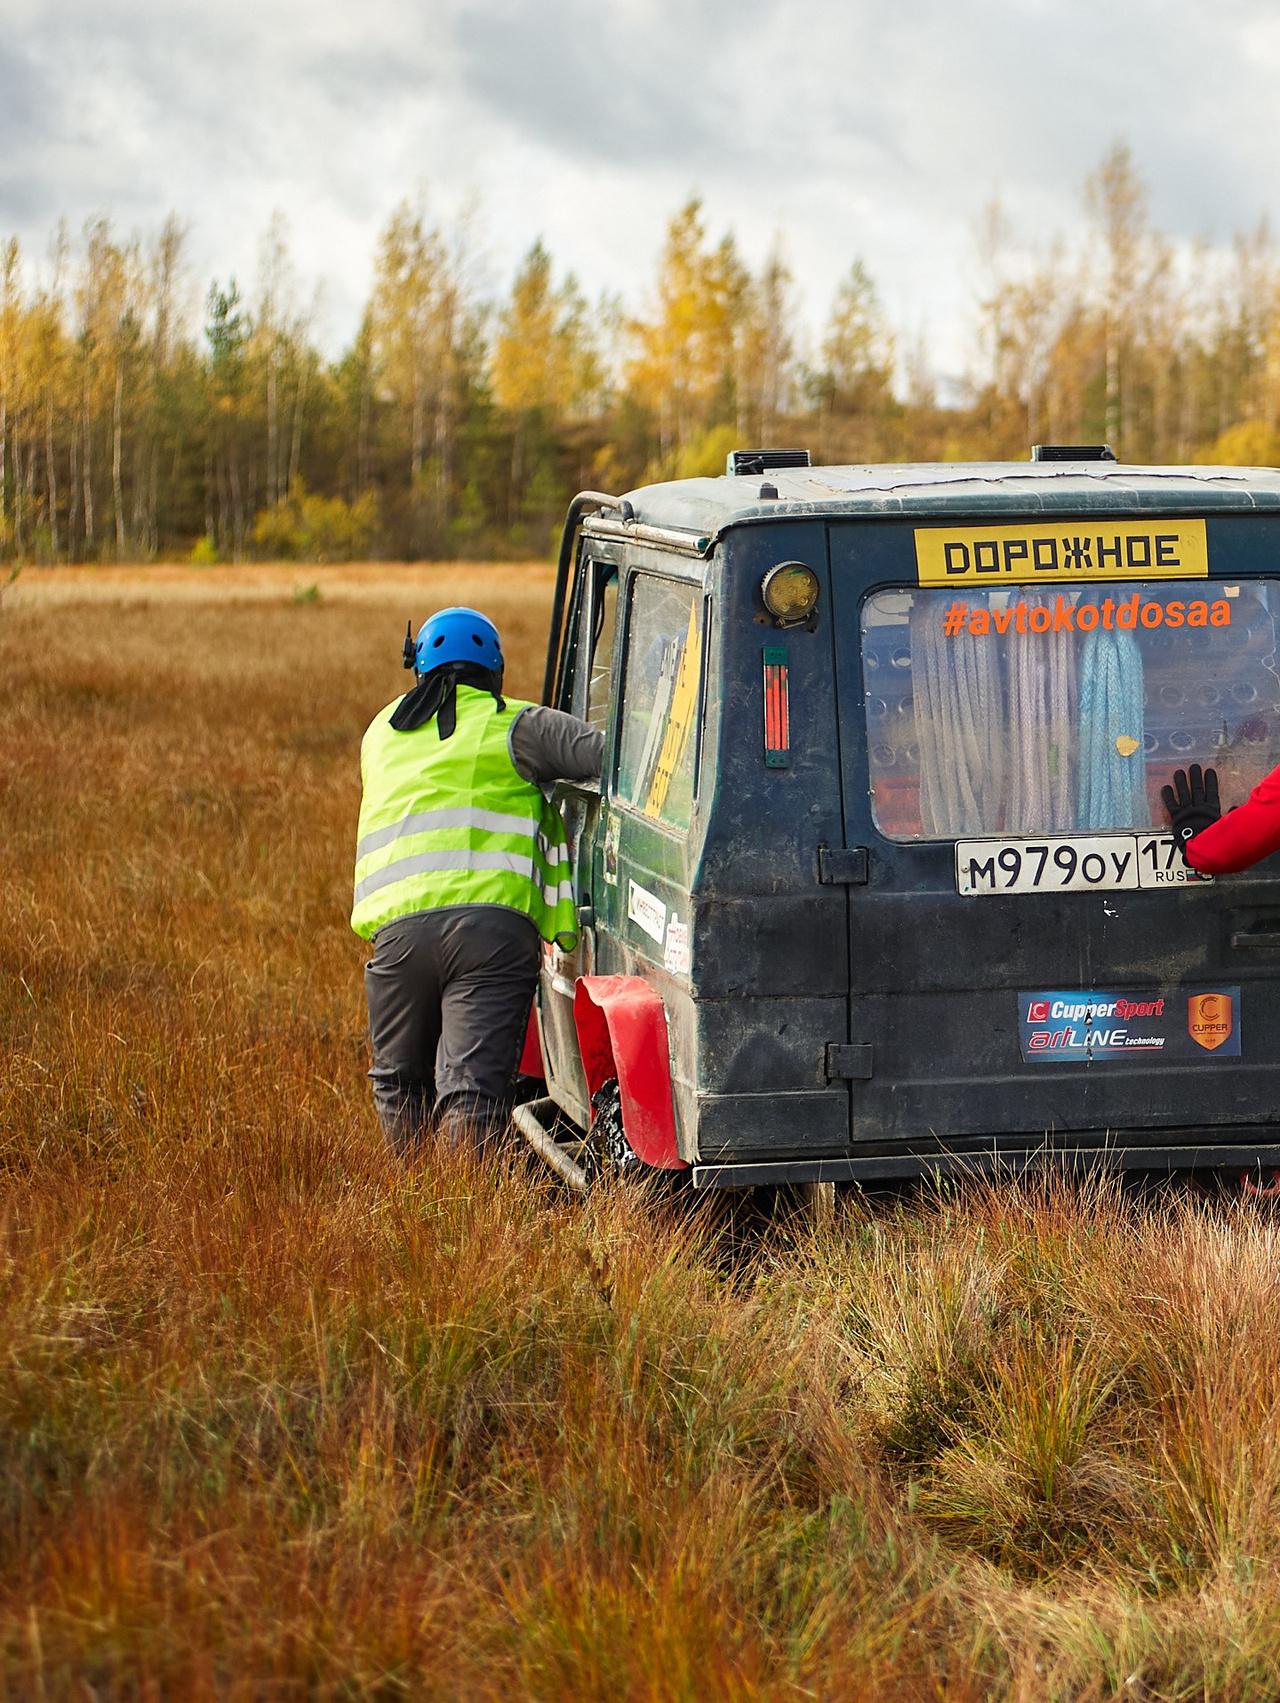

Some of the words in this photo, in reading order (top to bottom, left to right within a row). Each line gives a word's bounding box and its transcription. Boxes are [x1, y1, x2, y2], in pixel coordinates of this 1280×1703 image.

[942, 593, 1232, 637] #avtokotdosaa
[1141, 840, 1192, 871] 17
[1156, 871, 1185, 882] RUS
[1192, 1023, 1228, 1032] CUPPER
[1125, 1037, 1165, 1046] technology
